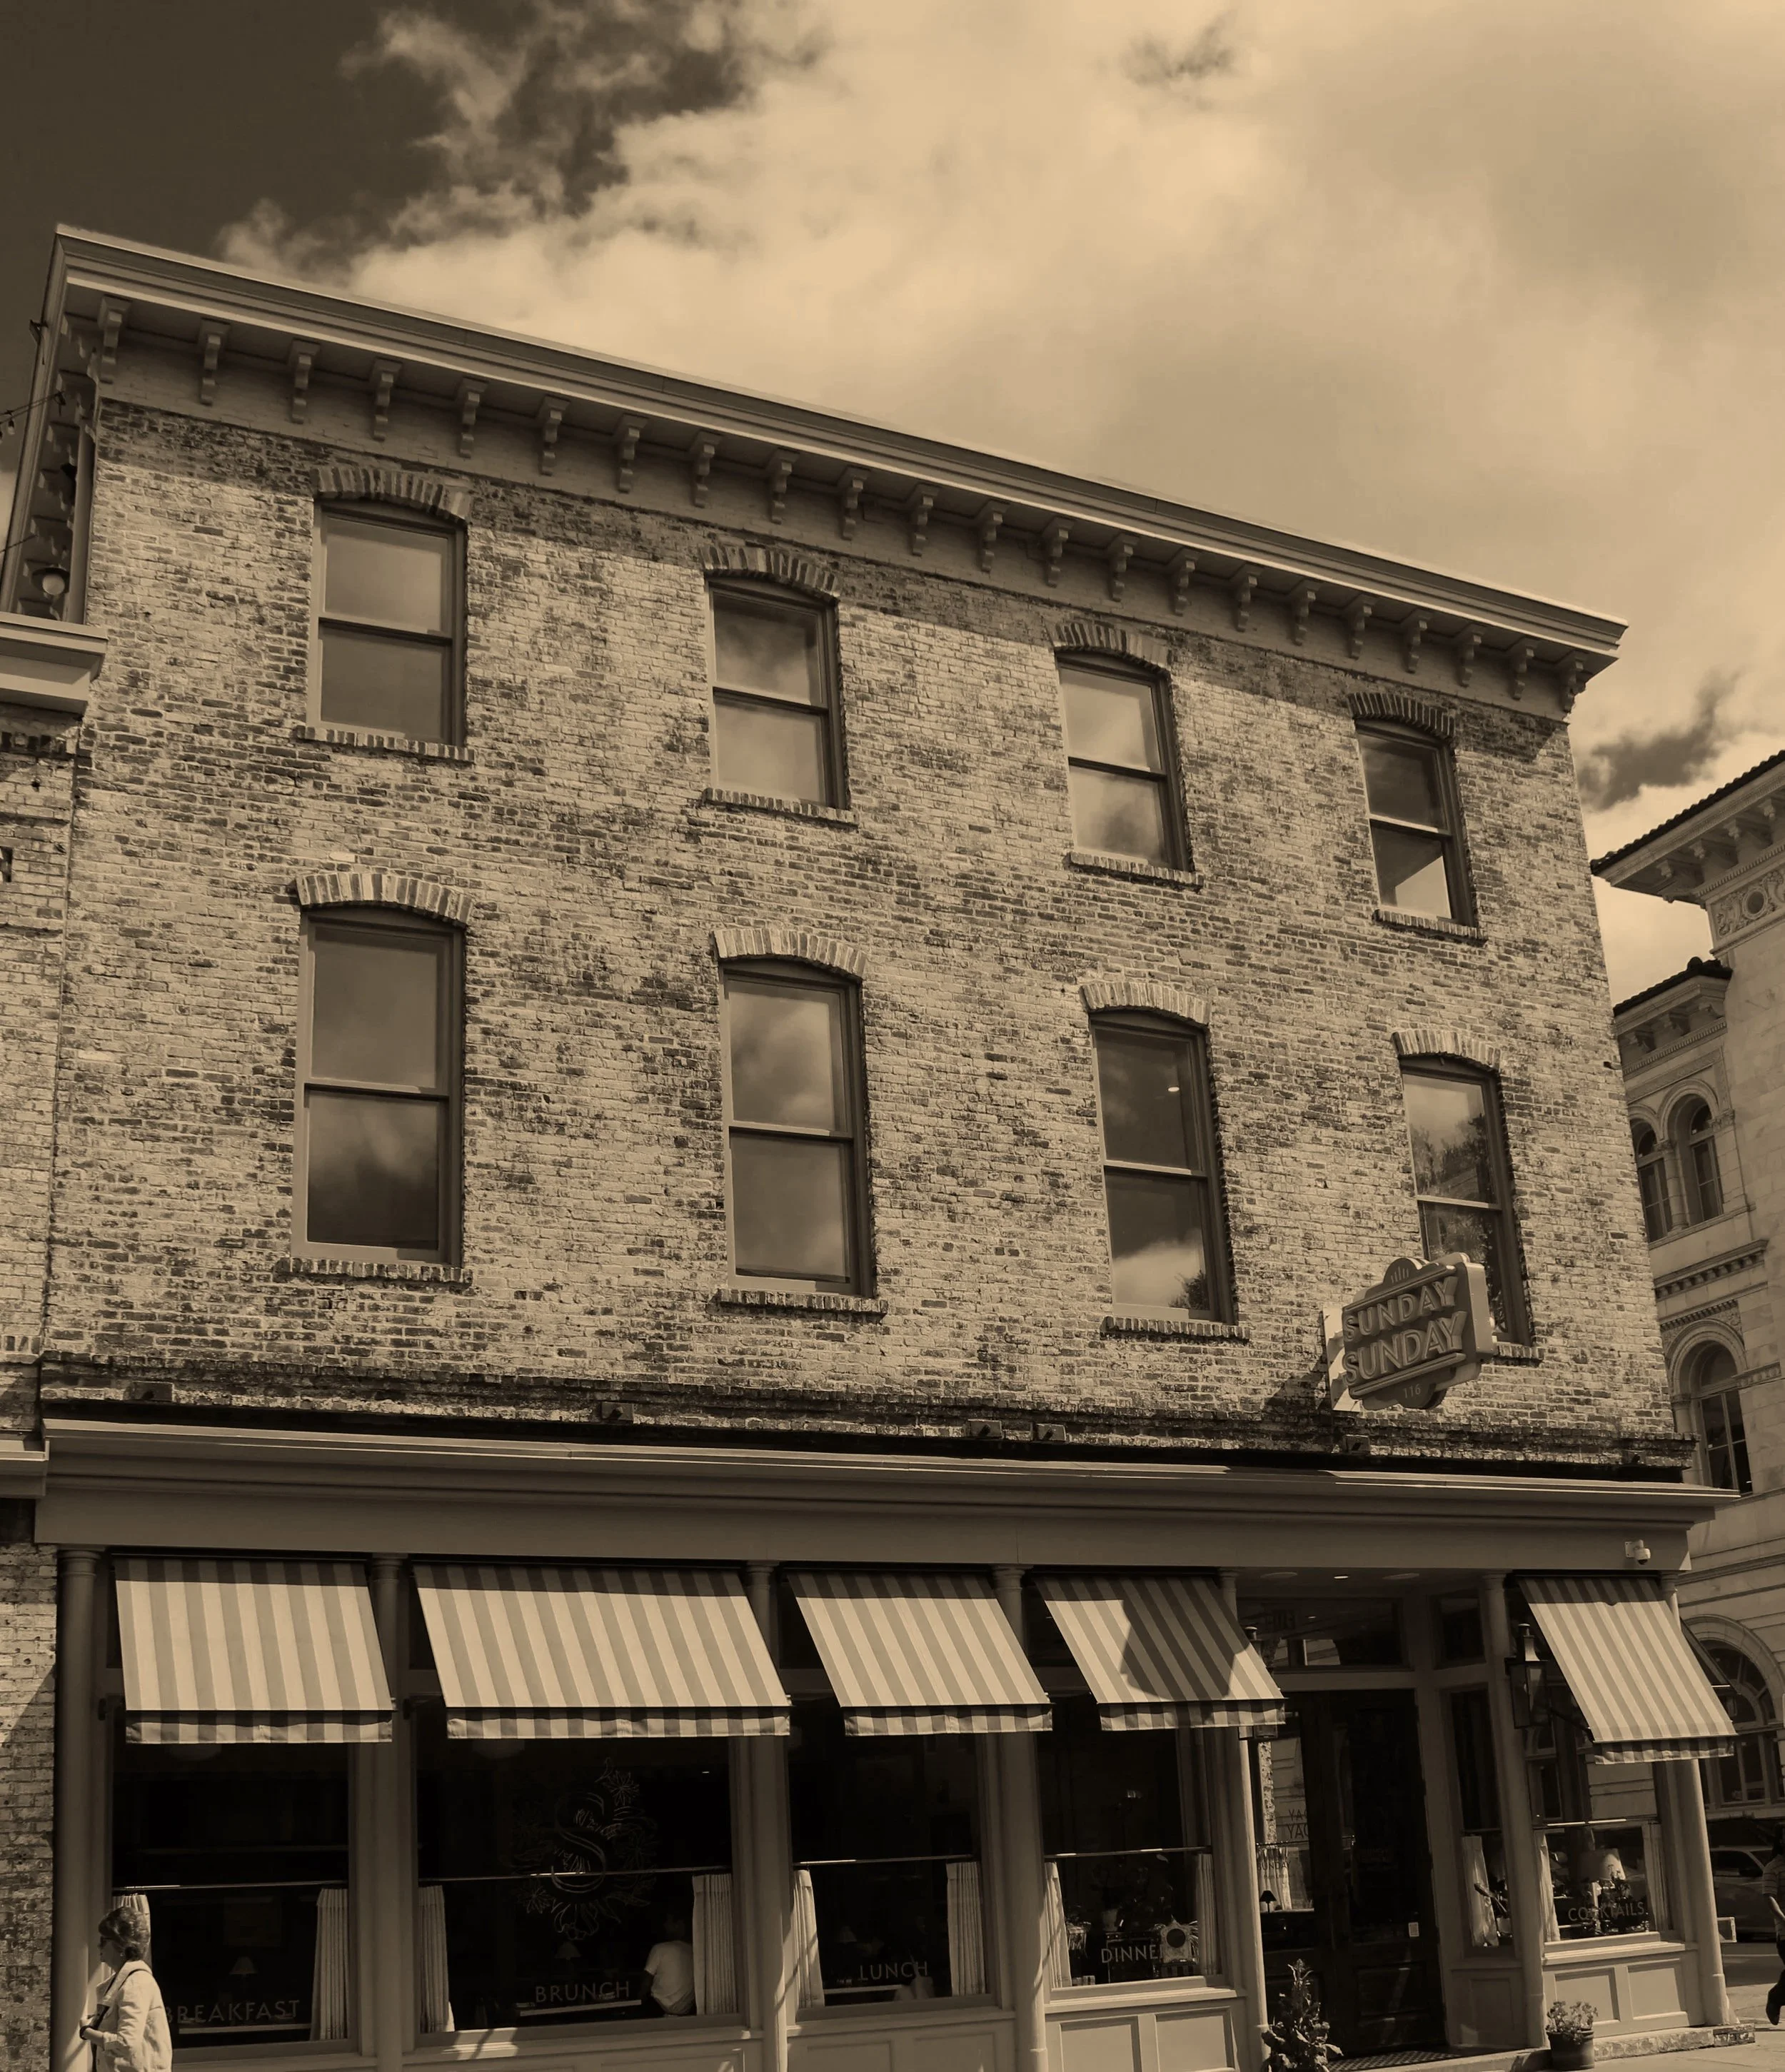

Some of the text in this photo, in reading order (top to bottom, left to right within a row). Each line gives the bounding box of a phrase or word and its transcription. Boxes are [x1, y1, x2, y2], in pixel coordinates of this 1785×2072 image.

[1343, 1276, 1458, 1342] SUNDAY
[1342, 1311, 1467, 1386] SUNDAY
[1403, 1384, 1422, 1399] 116
[1567, 1901, 1645, 1921] COKTAILS
[859, 1961, 928, 1981] LUNCH
[536, 1981, 630, 2003] BRUNCH
[165, 1999, 301, 2023] BREAKFAST
